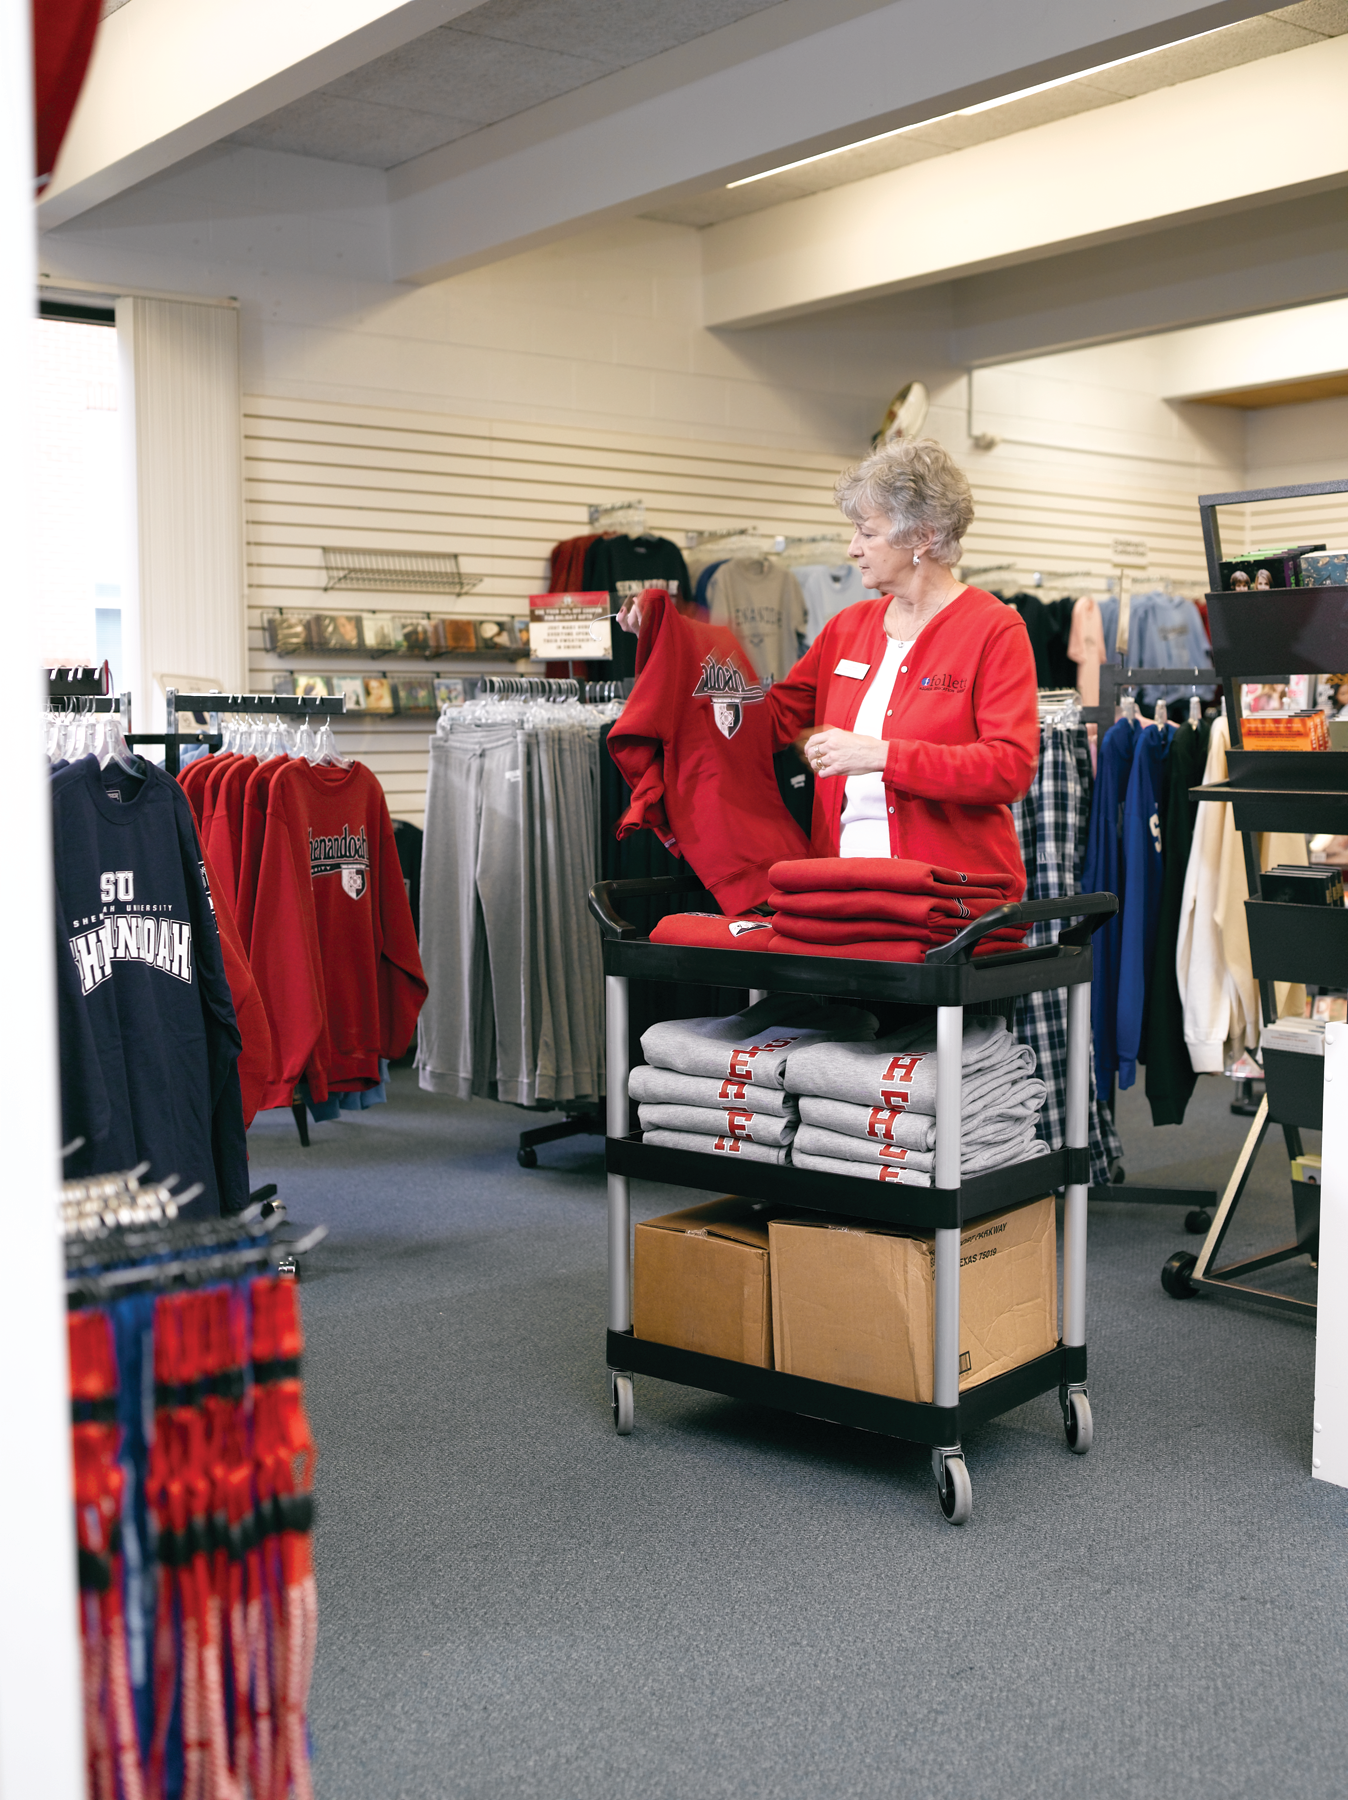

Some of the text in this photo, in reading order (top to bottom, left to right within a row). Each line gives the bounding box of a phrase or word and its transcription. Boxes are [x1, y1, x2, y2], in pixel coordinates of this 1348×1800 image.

[930, 674, 967, 689] follett
[308, 823, 368, 861] henandoah
[100, 871, 134, 903] SU
[960, 1247, 998, 1268] EXAS 75019
